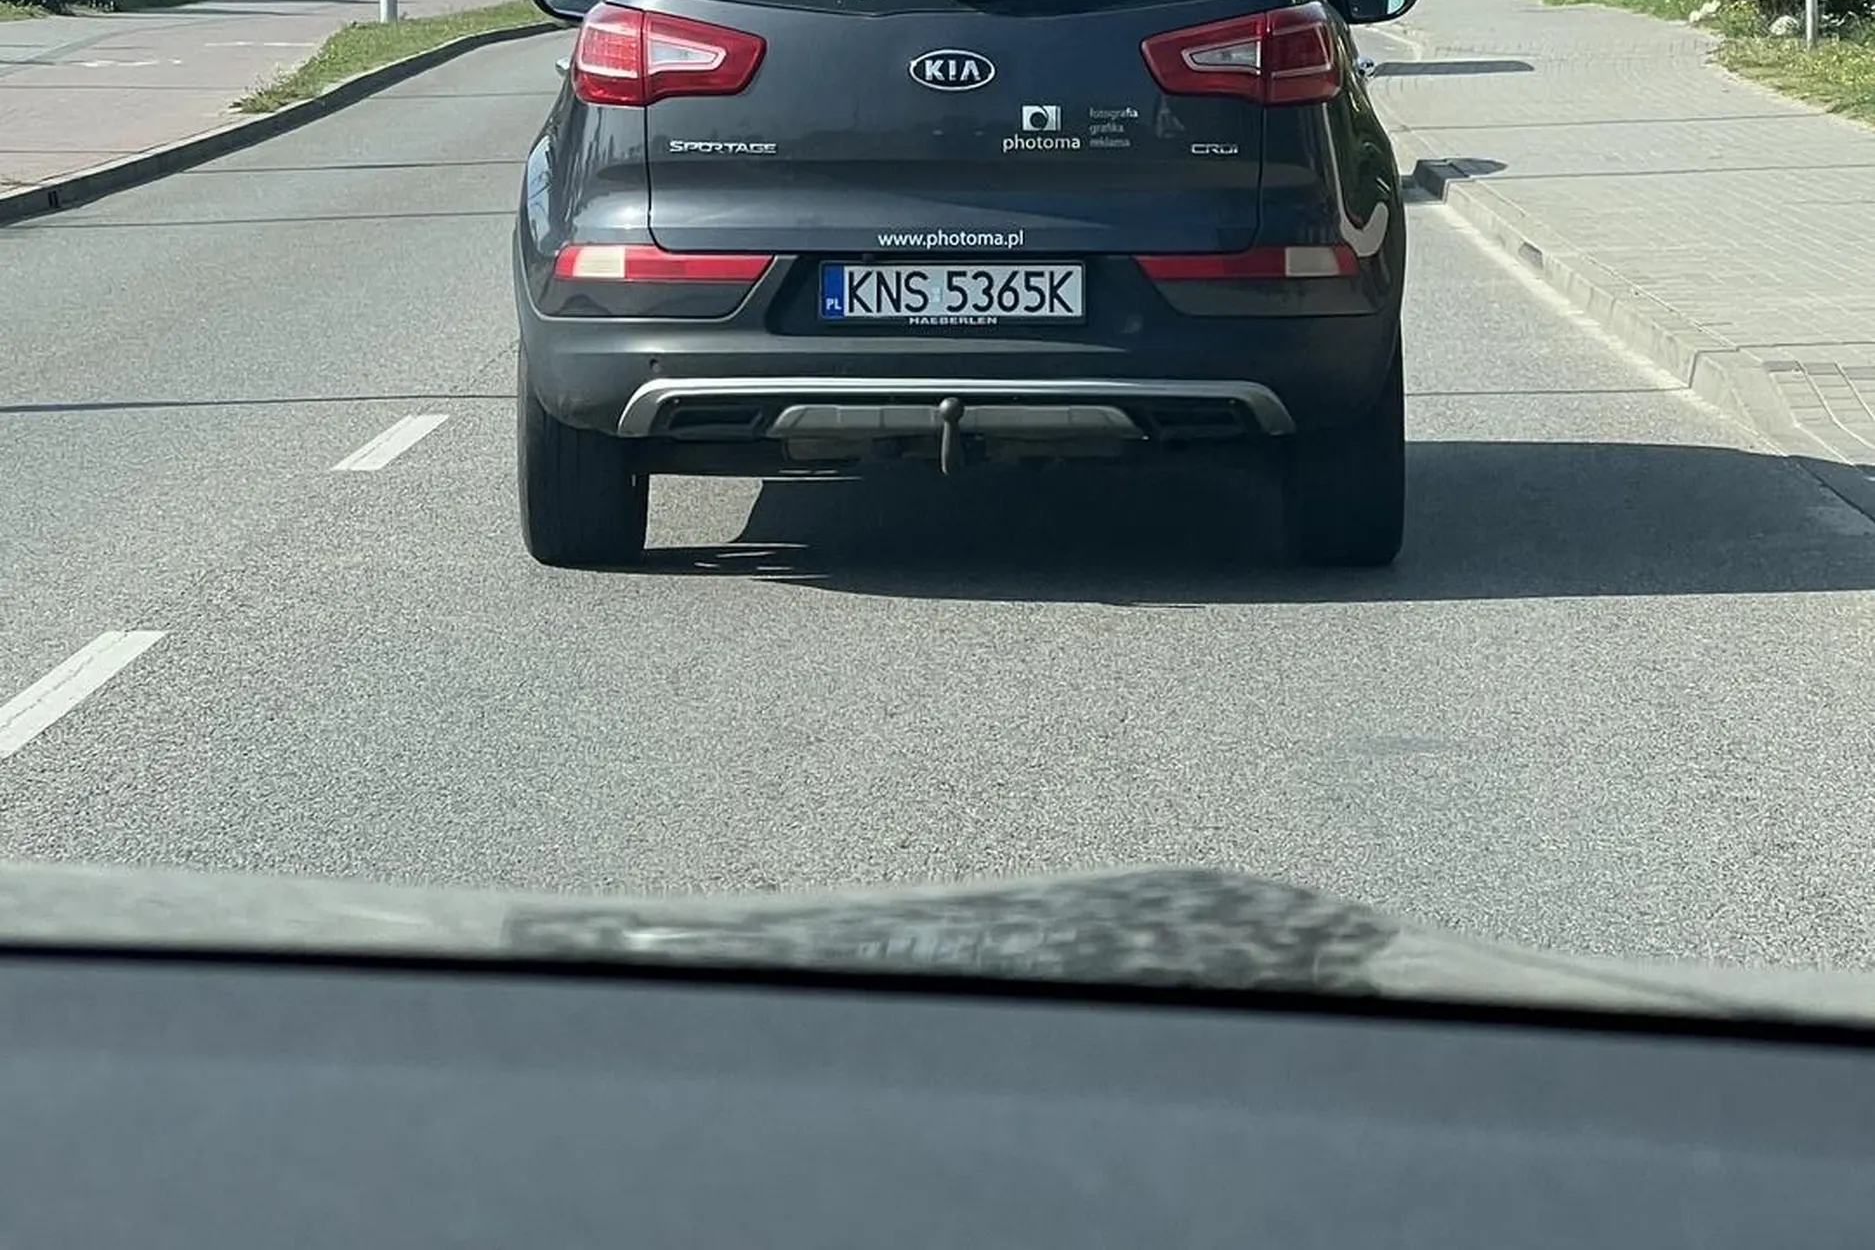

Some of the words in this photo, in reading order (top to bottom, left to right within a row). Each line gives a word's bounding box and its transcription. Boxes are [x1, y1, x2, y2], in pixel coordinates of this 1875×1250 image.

[924, 59, 981, 81] KIA
[1089, 122, 1124, 135] grafika
[669, 140, 777, 154] SPORTAGE
[1003, 134, 1081, 153] photoma
[878, 230, 1024, 249] www.photoma.pl
[848, 270, 929, 314] KNS
[946, 270, 1074, 314] 5365K
[826, 298, 841, 310] PL
[908, 317, 998, 325] HAEBERLEN
